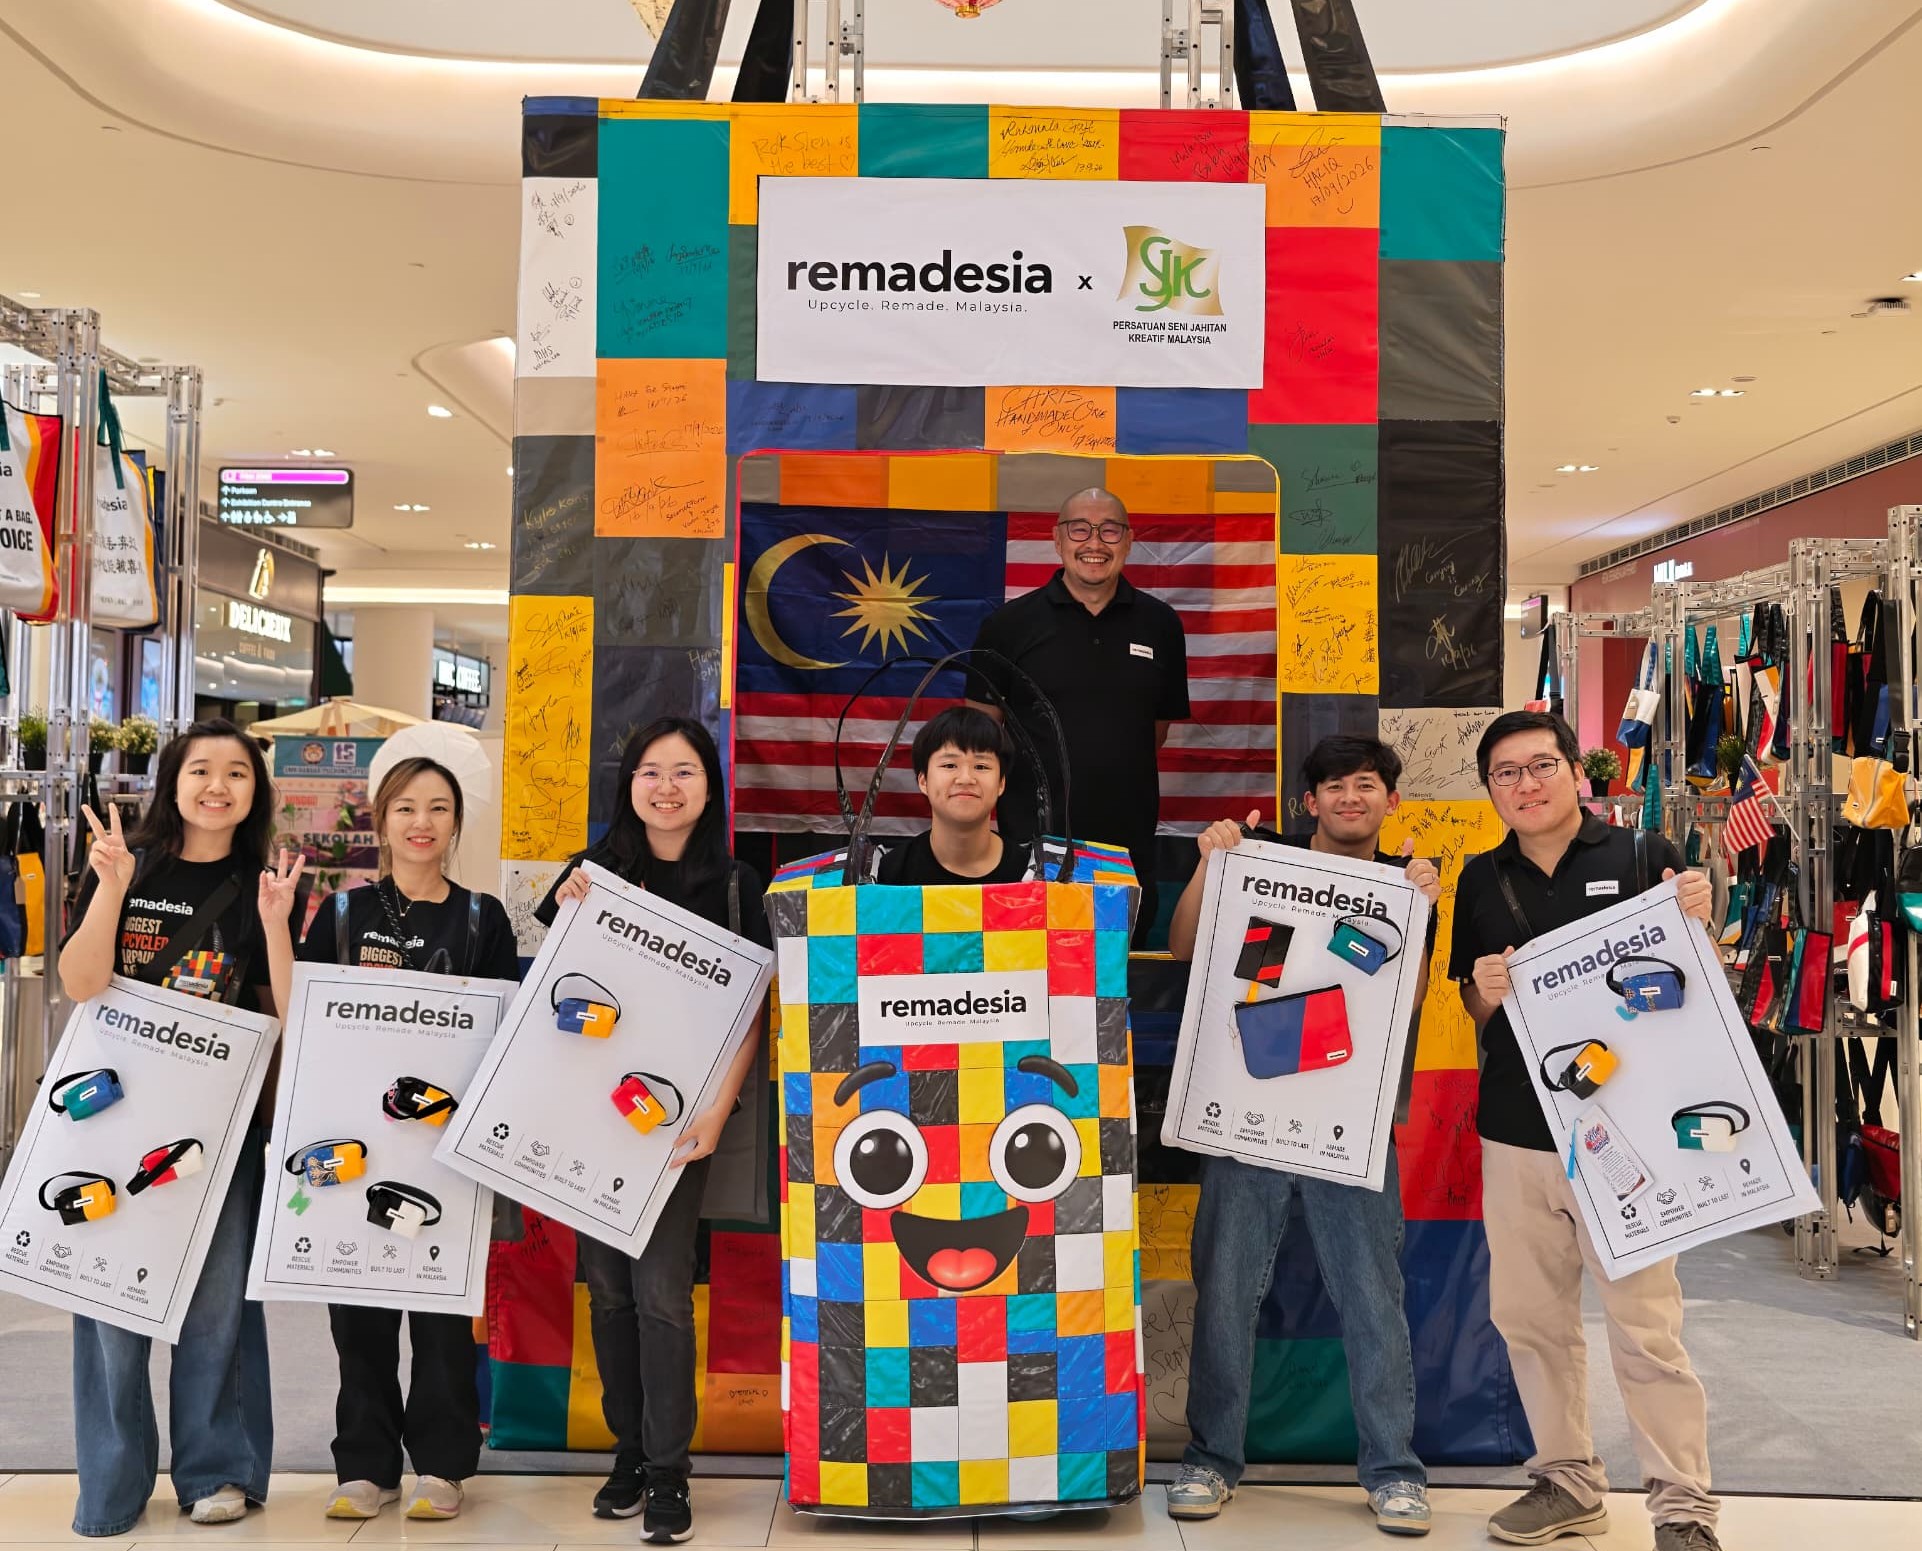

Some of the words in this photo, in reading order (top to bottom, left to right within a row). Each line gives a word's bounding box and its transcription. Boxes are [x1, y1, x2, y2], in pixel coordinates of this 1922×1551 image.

[786, 249, 1053, 293] remadesia
[1078, 272, 1094, 291] x
[808, 299, 874, 314] Upcycle.
[880, 299, 949, 313] Remade.
[955, 299, 1027, 314] Malaysia.
[1113, 320, 1166, 333] PERSATUAN
[1167, 321, 1189, 333] SENI
[1190, 321, 1227, 334] JAHITAN
[1128, 332, 1166, 344] KREATIF
[1166, 333, 1212, 345] MALAYSIA
[1001, 387, 1083, 413] CHRIS
[5, 509, 13, 521] A
[0, 527, 34, 551] OICE
[303, 832, 374, 845] SEKOLAH
[129, 898, 194, 916] emadesia
[1242, 875, 1389, 920] remadesia
[595, 908, 733, 988] remadesia
[1531, 924, 1667, 995] remadesia
[325, 1000, 475, 1030] remadesia
[881, 989, 1027, 1018] remadesia
[95, 1002, 232, 1062] remadesia
